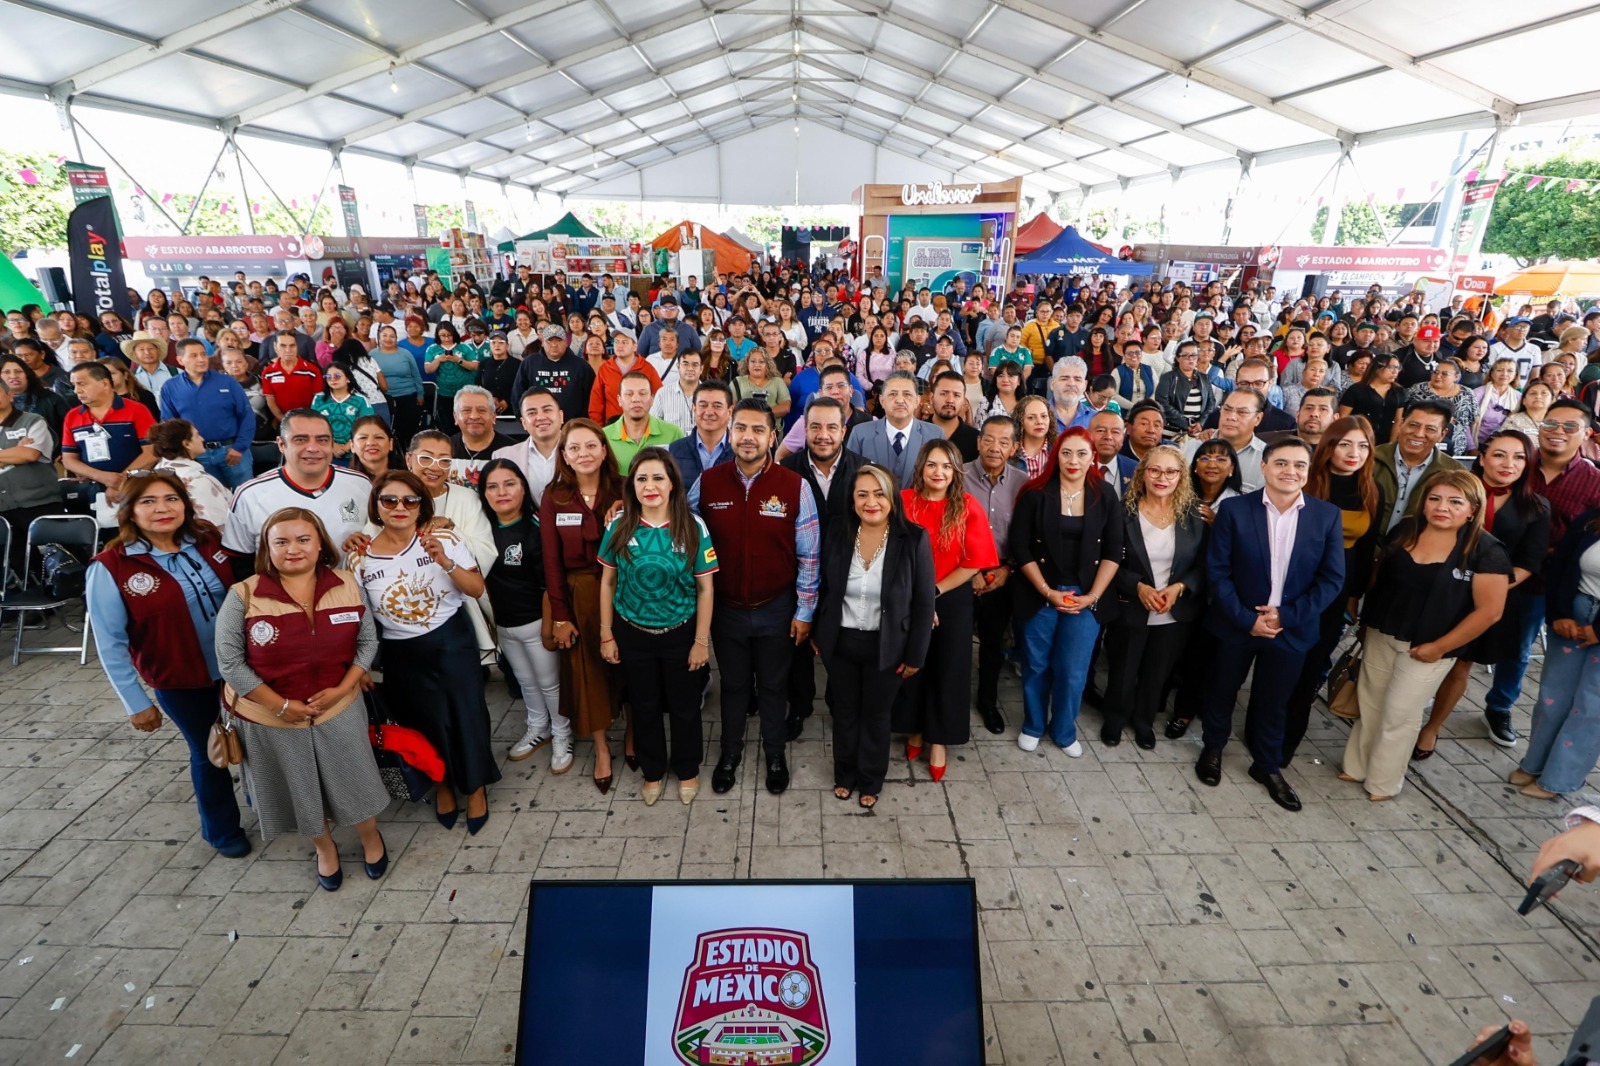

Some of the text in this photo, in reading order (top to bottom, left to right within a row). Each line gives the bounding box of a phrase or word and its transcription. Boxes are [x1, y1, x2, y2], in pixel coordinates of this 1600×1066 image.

[902, 180, 982, 206] Unilever
[160, 245, 273, 255] ESTADIO ABARROTERO
[352, 242, 360, 254] 4
[1311, 256, 1421, 267] ESTADIO ABARROTERO
[160, 264, 172, 272] LA
[1069, 265, 1100, 274] JUMEX
[705, 938, 800, 967] ESTADIO
[744, 964, 760, 972] DE
